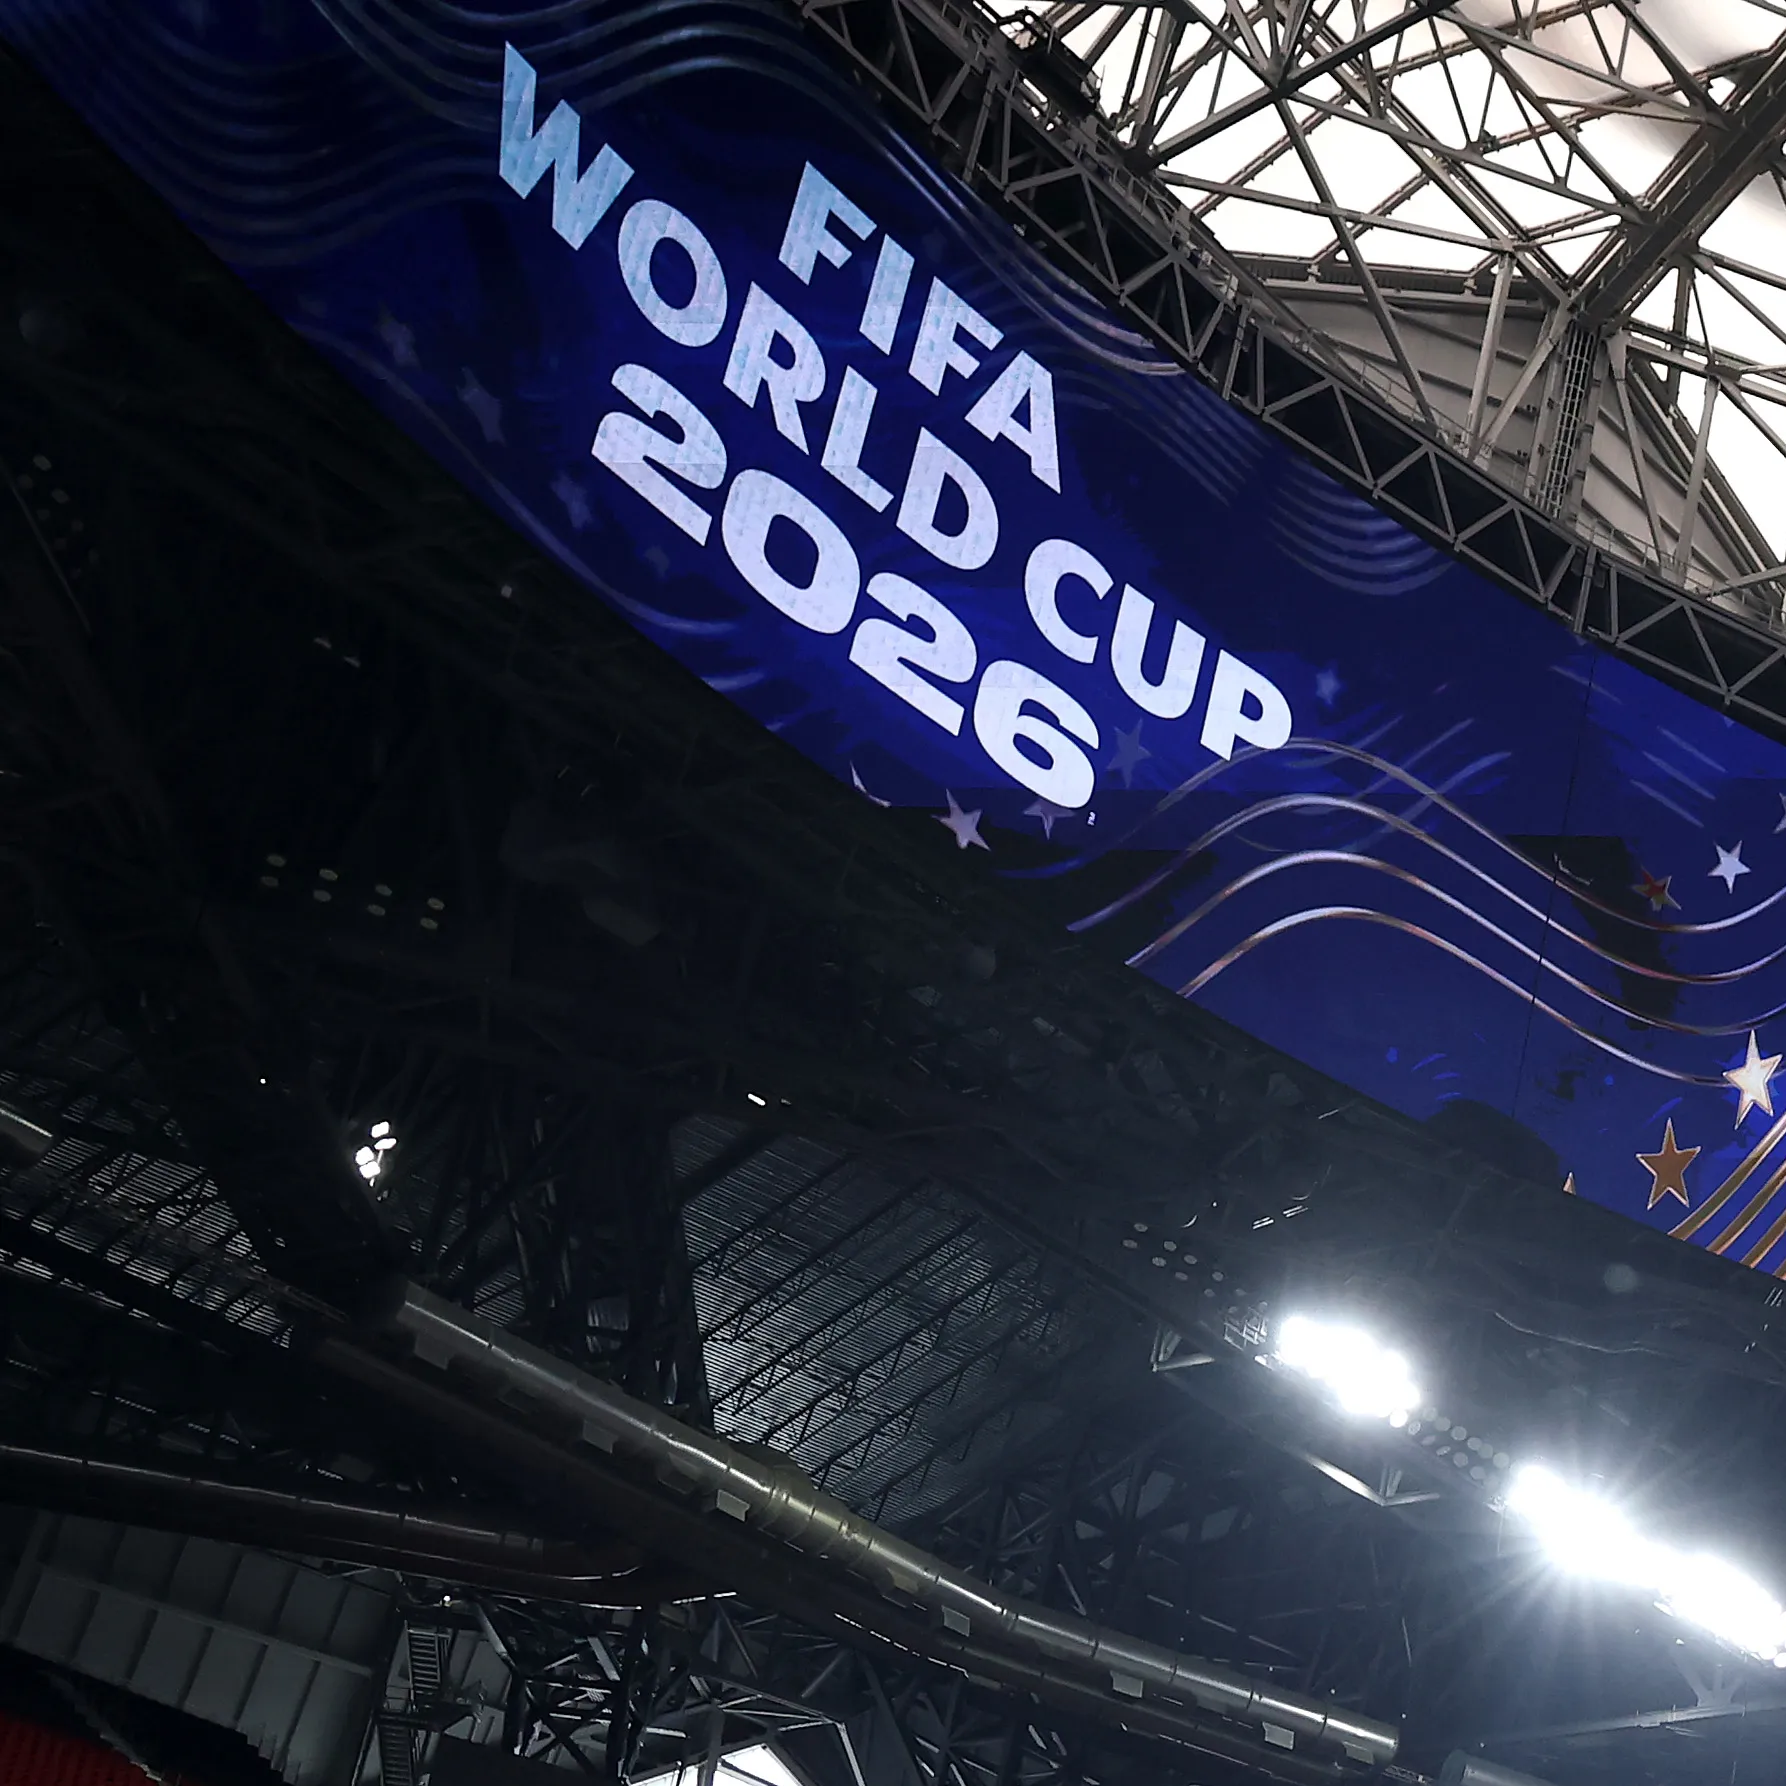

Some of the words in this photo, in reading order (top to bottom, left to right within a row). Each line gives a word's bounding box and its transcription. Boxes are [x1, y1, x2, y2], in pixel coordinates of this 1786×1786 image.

[498, 40, 1001, 571] WORLD
[1022, 536, 1294, 762] CUP
[779, 158, 1063, 496] FIFA
[590, 362, 1102, 811] 2026
